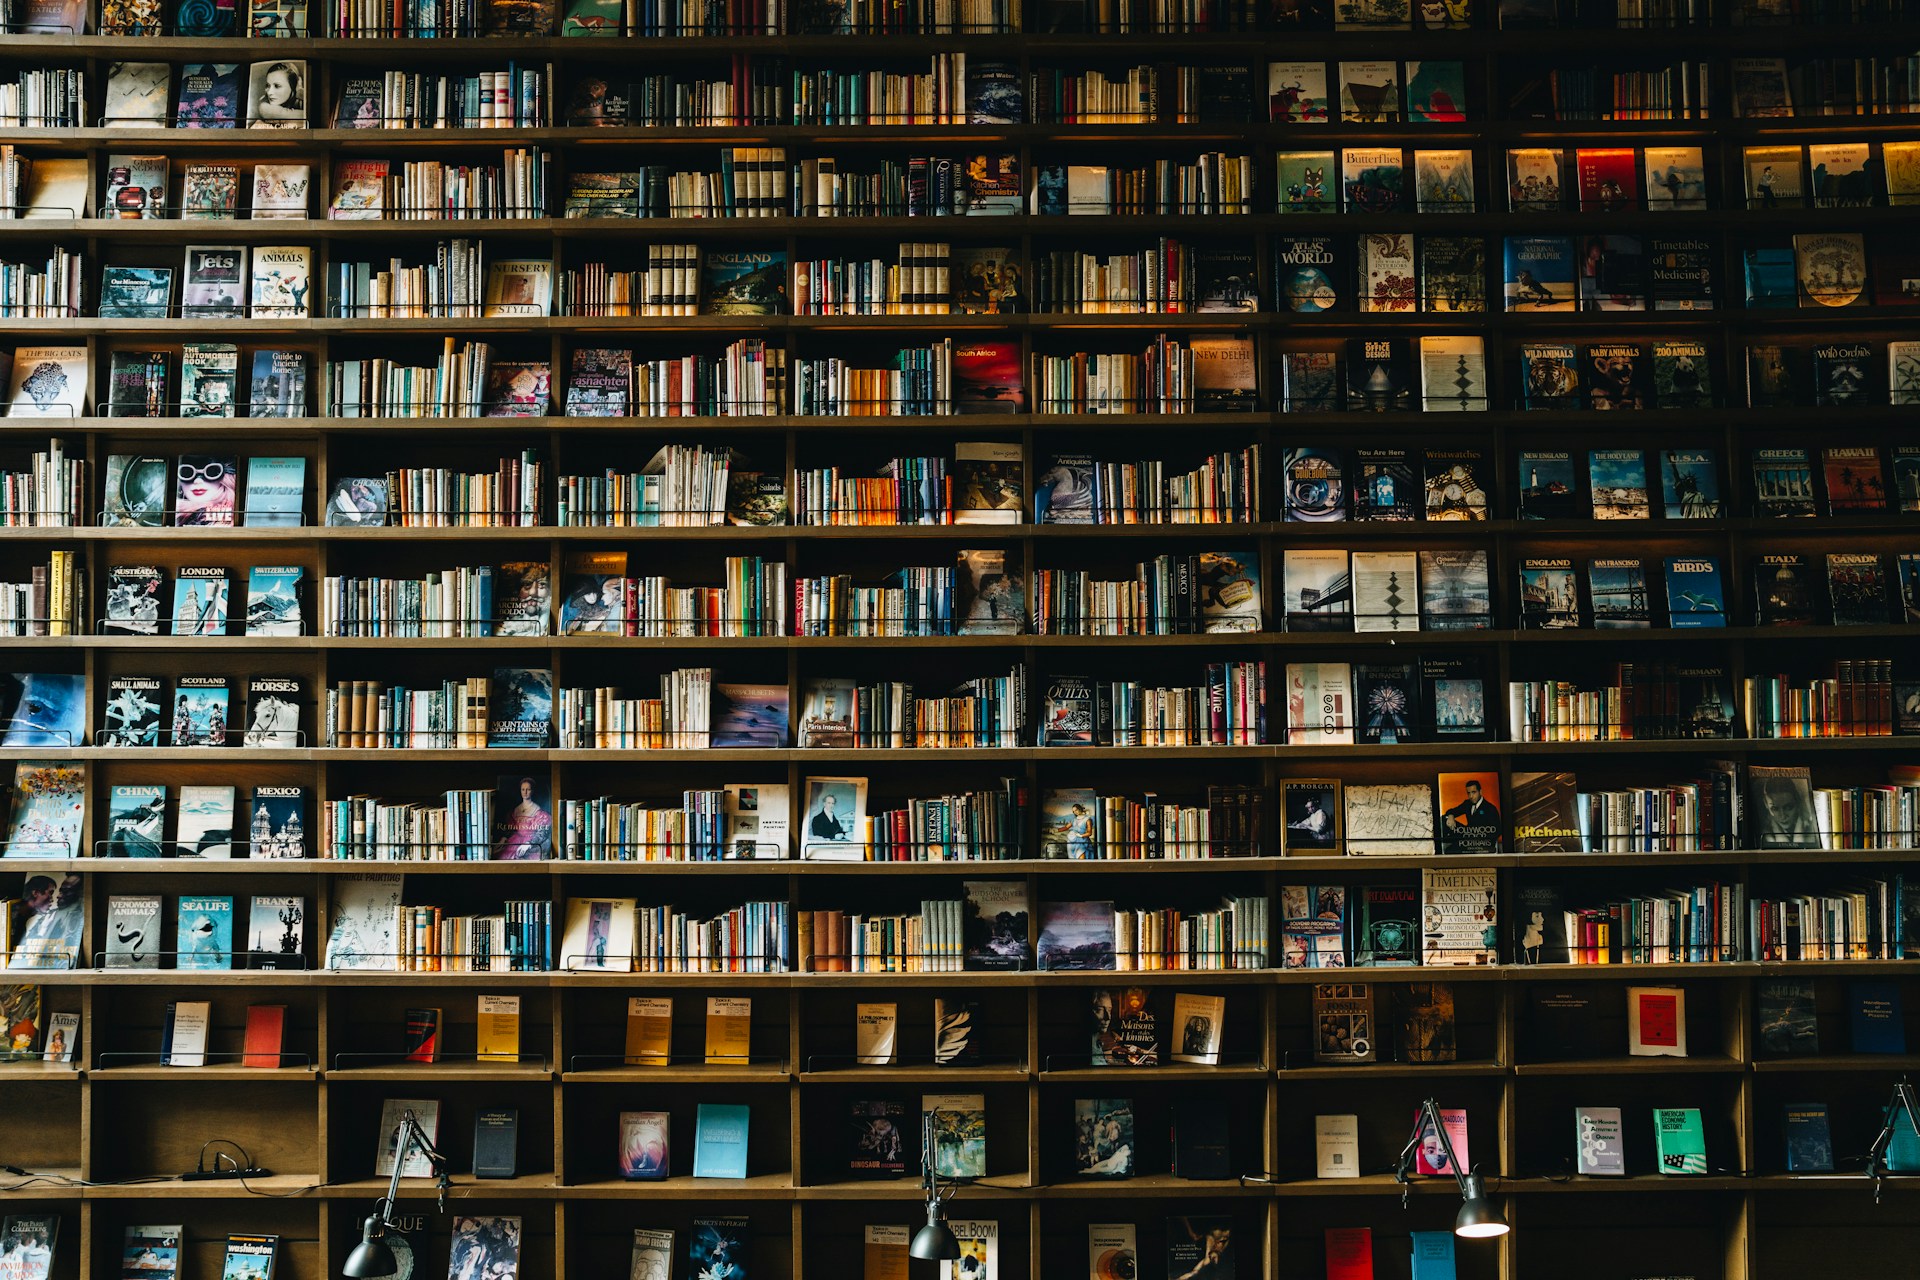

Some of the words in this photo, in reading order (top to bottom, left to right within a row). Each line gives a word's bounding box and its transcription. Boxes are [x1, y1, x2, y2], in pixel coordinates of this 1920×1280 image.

[1347, 153, 1400, 164] Butterflies
[257, 180, 307, 197] RAW
[975, 188, 1019, 196] Chemistry
[1291, 243, 1324, 253] ATLAS
[1652, 240, 1709, 250] Timetables
[261, 254, 302, 262] ANIMALS
[708, 254, 771, 264] ENGLAND
[1282, 253, 1333, 264] WORLD
[1518, 252, 1561, 260] GEOGRAPHIC
[1653, 255, 1664, 265] of
[198, 254, 234, 271] Jets
[1654, 270, 1700, 280] Medicine
[499, 305, 533, 313] STYLE
[1196, 350, 1218, 360] NEW
[1222, 350, 1250, 360] DELHI
[1524, 350, 1541, 358] WILD
[1542, 350, 1574, 358] ANIMALS
[1590, 348, 1610, 357] BABY
[1611, 348, 1639, 357] ANIMALS
[1656, 347, 1673, 357] ZOO
[1673, 347, 1705, 357] ANIMALS
[1818, 350, 1837, 358] Wild
[1840, 348, 1870, 358] Orchids
[1426, 450, 1481, 459] Wristwatches
[1829, 449, 1875, 457] HAWAII
[1295, 469, 1327, 479] GUIDEBOOK
[759, 484, 781, 492] Salads
[1764, 555, 1798, 563] ITALY
[1833, 555, 1878, 563] CANADA
[1673, 563, 1714, 573] BIRDS
[112, 681, 132, 689] SMALL
[133, 681, 160, 689] ANIMALS
[251, 682, 299, 693] HORSES
[1048, 686, 1091, 700] QUILTS
[1213, 682, 1223, 713] Wine
[116, 787, 161, 796] CHINA
[1368, 789, 1415, 812] JEAN
[1454, 826, 1496, 834] HOLLYWOOD
[1514, 827, 1580, 838] Kitchens
[366, 874, 400, 882] PAINTING
[1430, 874, 1495, 887] TIMELINES
[1437, 892, 1484, 903] ANCIENT
[182, 902, 204, 911] SEA
[204, 902, 230, 911] LIFE
[1441, 904, 1480, 914] WORLD
[52, 1015, 78, 1026] Amis
[1139, 1011, 1154, 1022] Des
[1121, 1020, 1154, 1030] Maisons
[1120, 1032, 1154, 1042] Hommes
[970, 1222, 996, 1238] BOOM
[636, 1236, 650, 1246] HOMO
[651, 1238, 671, 1248] ERECTUS
[228, 1243, 273, 1255] washington
